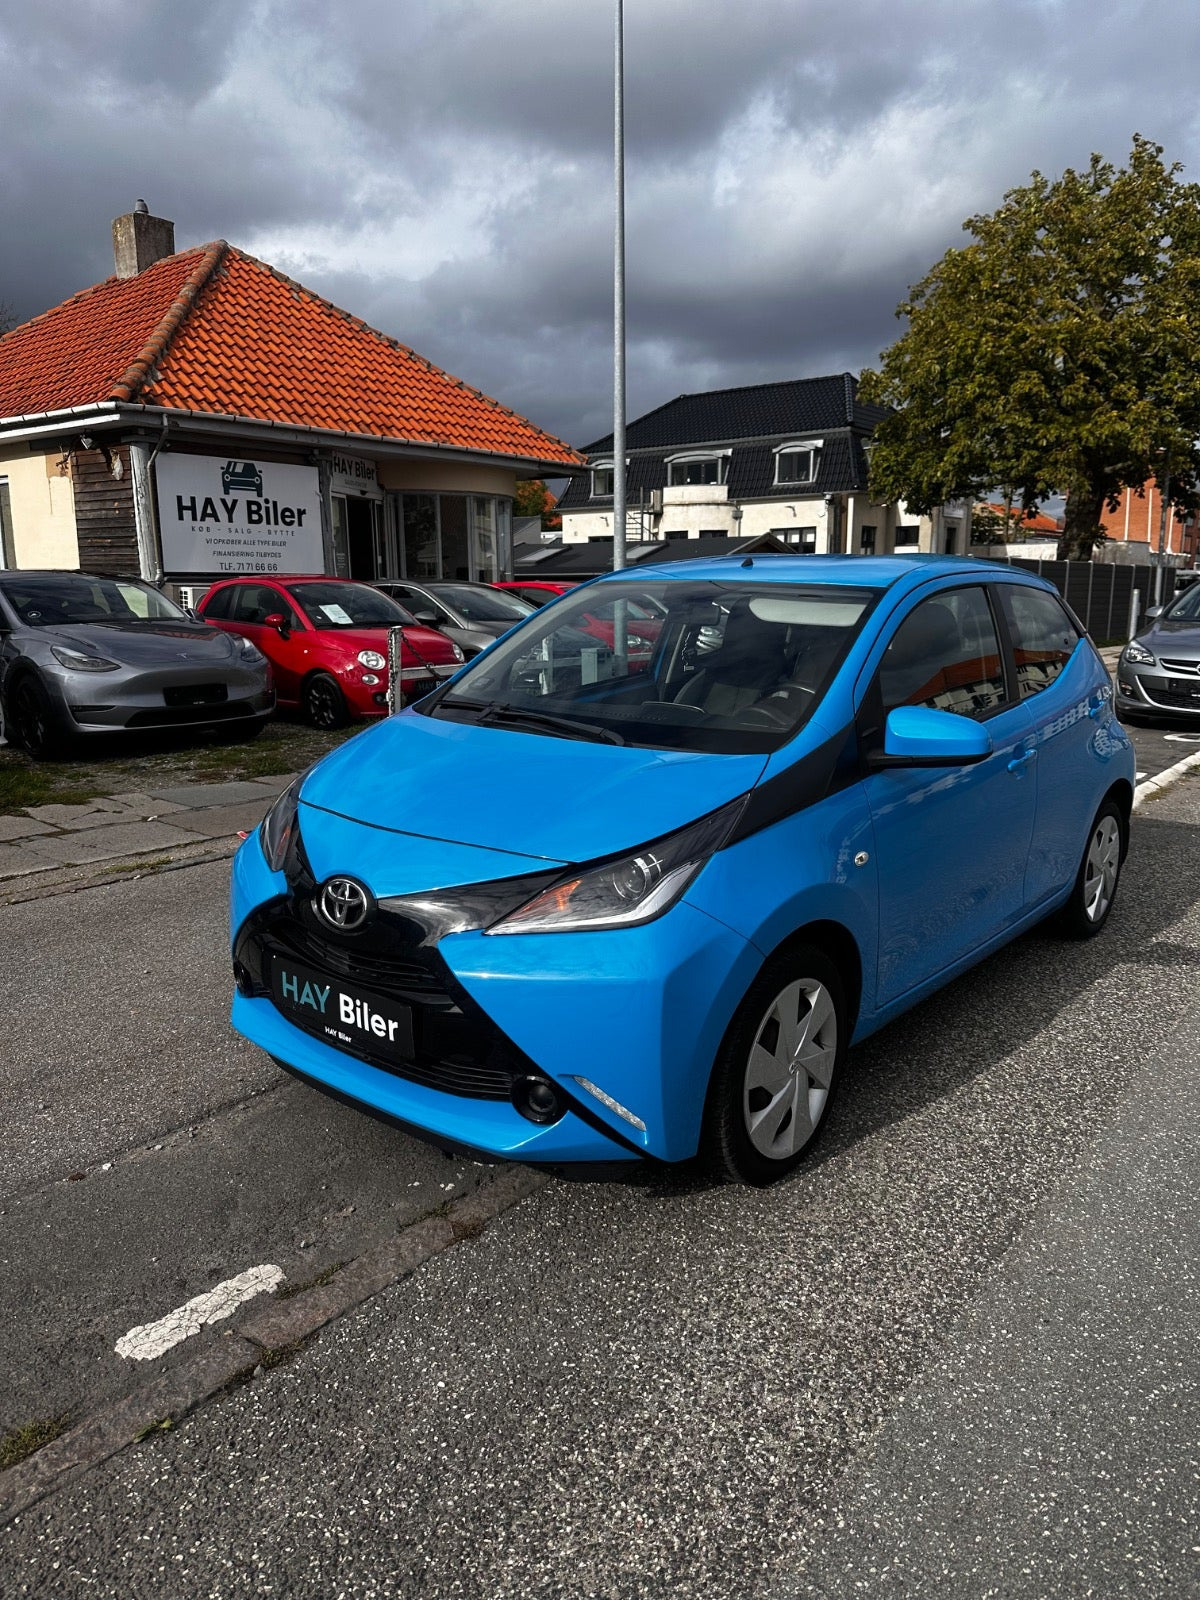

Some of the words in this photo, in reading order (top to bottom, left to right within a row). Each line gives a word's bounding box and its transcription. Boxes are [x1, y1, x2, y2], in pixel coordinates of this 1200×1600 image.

[334, 456, 353, 476] HAY
[355, 460, 374, 480] Biler
[176, 495, 238, 523] HAY
[246, 498, 306, 527] Biler
[228, 527, 252, 535] SALG
[267, 529, 295, 537] BYTTE
[213, 538, 241, 546] OPKØBER
[256, 551, 282, 559] TILBYDES
[219, 562, 235, 571] TLF.
[237, 563, 245, 571] 71
[246, 563, 254, 571] 71
[255, 563, 265, 571] 66
[267, 563, 278, 572] 66
[281, 971, 331, 1014] HAY
[339, 992, 398, 1041] Biler
[324, 1025, 337, 1037] HAY
[338, 1031, 352, 1043] Biler
